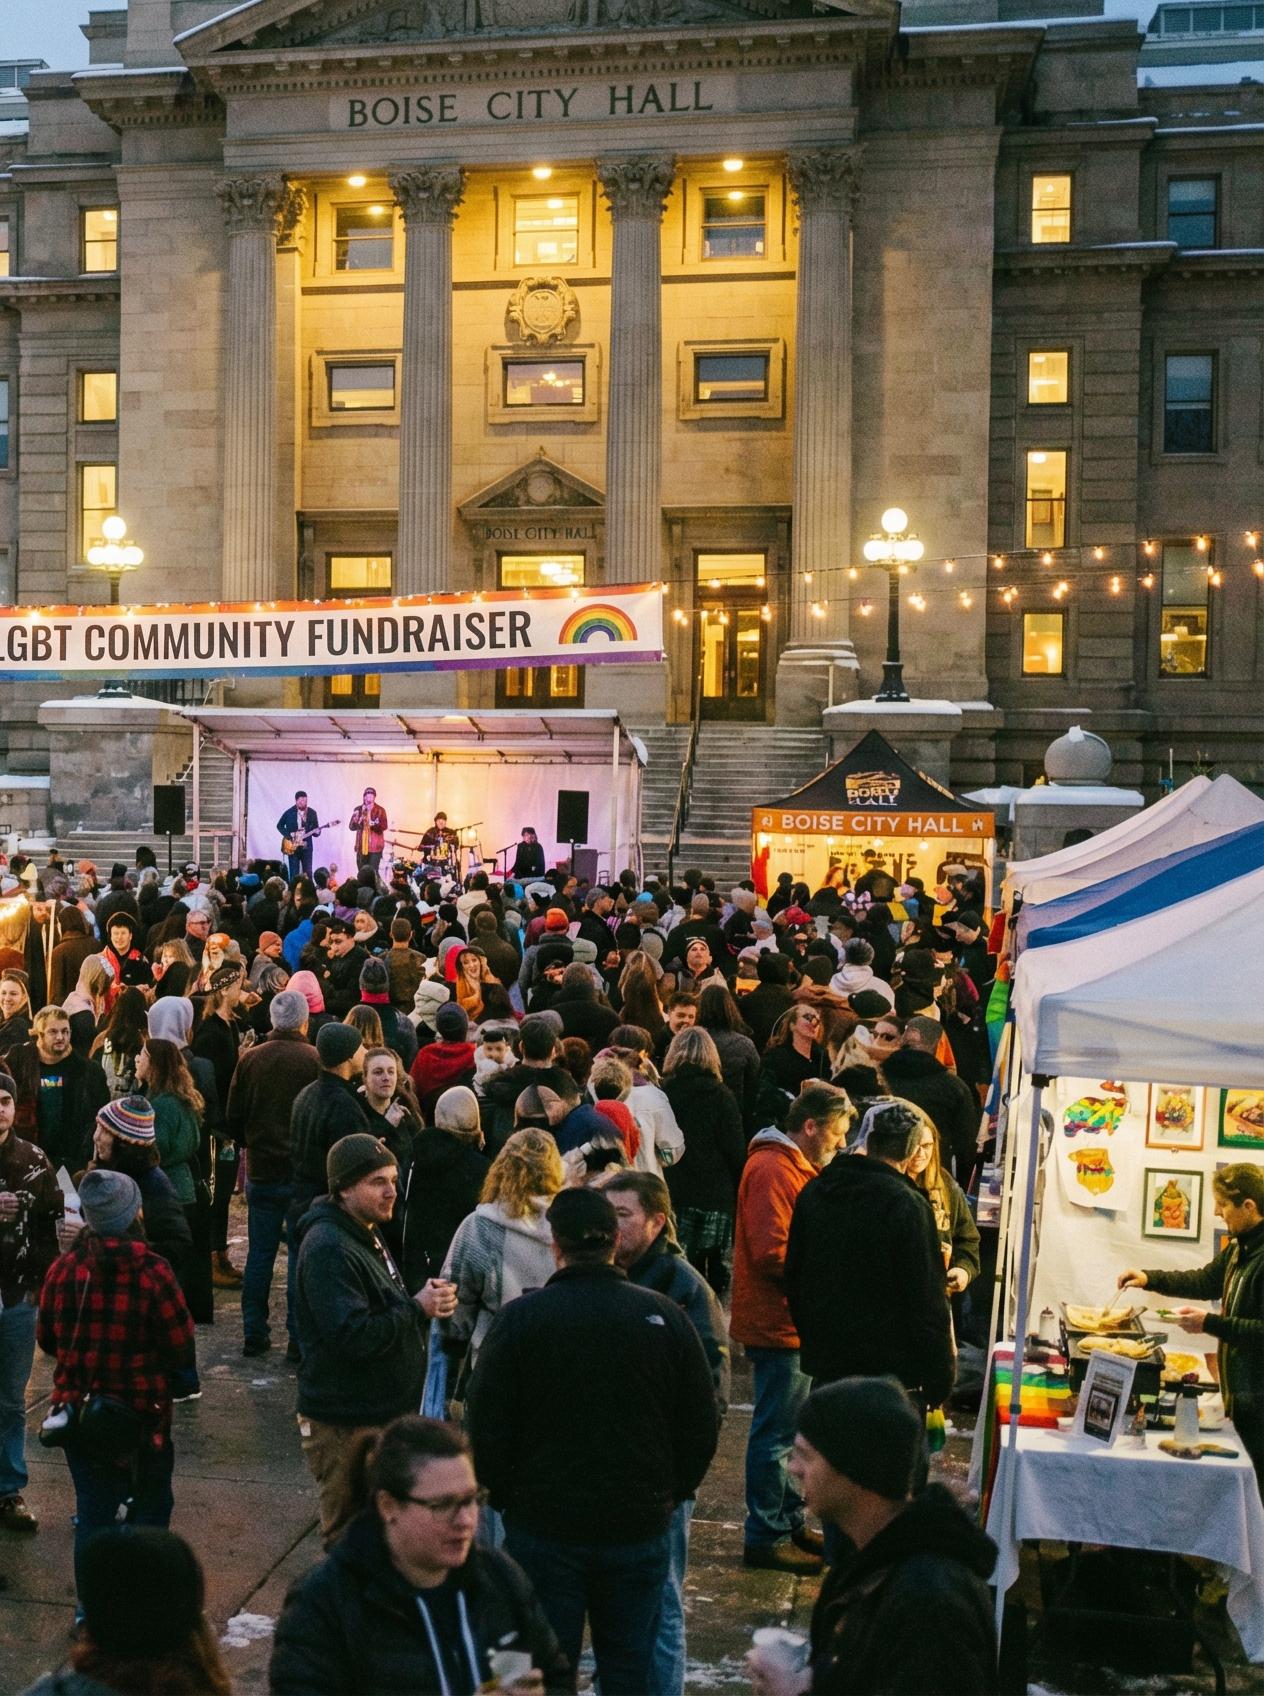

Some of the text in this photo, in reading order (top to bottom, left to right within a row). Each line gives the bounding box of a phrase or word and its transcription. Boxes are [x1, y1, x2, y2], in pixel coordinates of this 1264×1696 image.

[348, 81, 713, 128] BOISE CITY HALL
[525, 527, 560, 540] CITY
[85, 620, 295, 661] COMMUNITY
[308, 610, 532, 657] FUNDRAISER
[781, 814, 964, 834] BOISE CITY HALL
